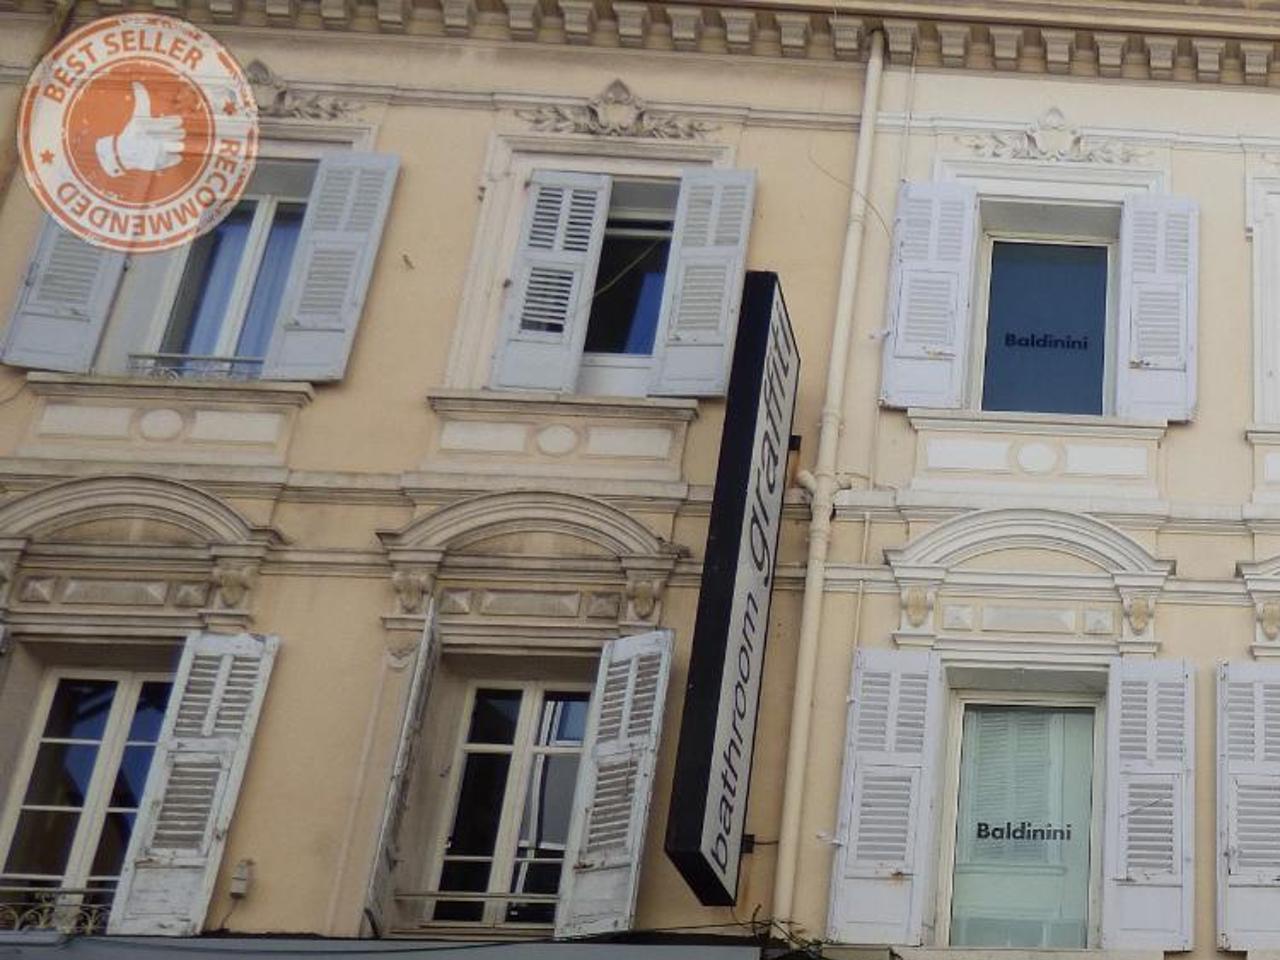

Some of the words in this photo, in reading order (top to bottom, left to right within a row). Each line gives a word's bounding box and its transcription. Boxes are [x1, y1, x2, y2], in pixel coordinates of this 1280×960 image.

[1004, 332, 1089, 351] Baldinini
[710, 592, 759, 876] bathroom
[747, 306, 794, 588] graffiti
[976, 822, 1072, 841] Baldinini
